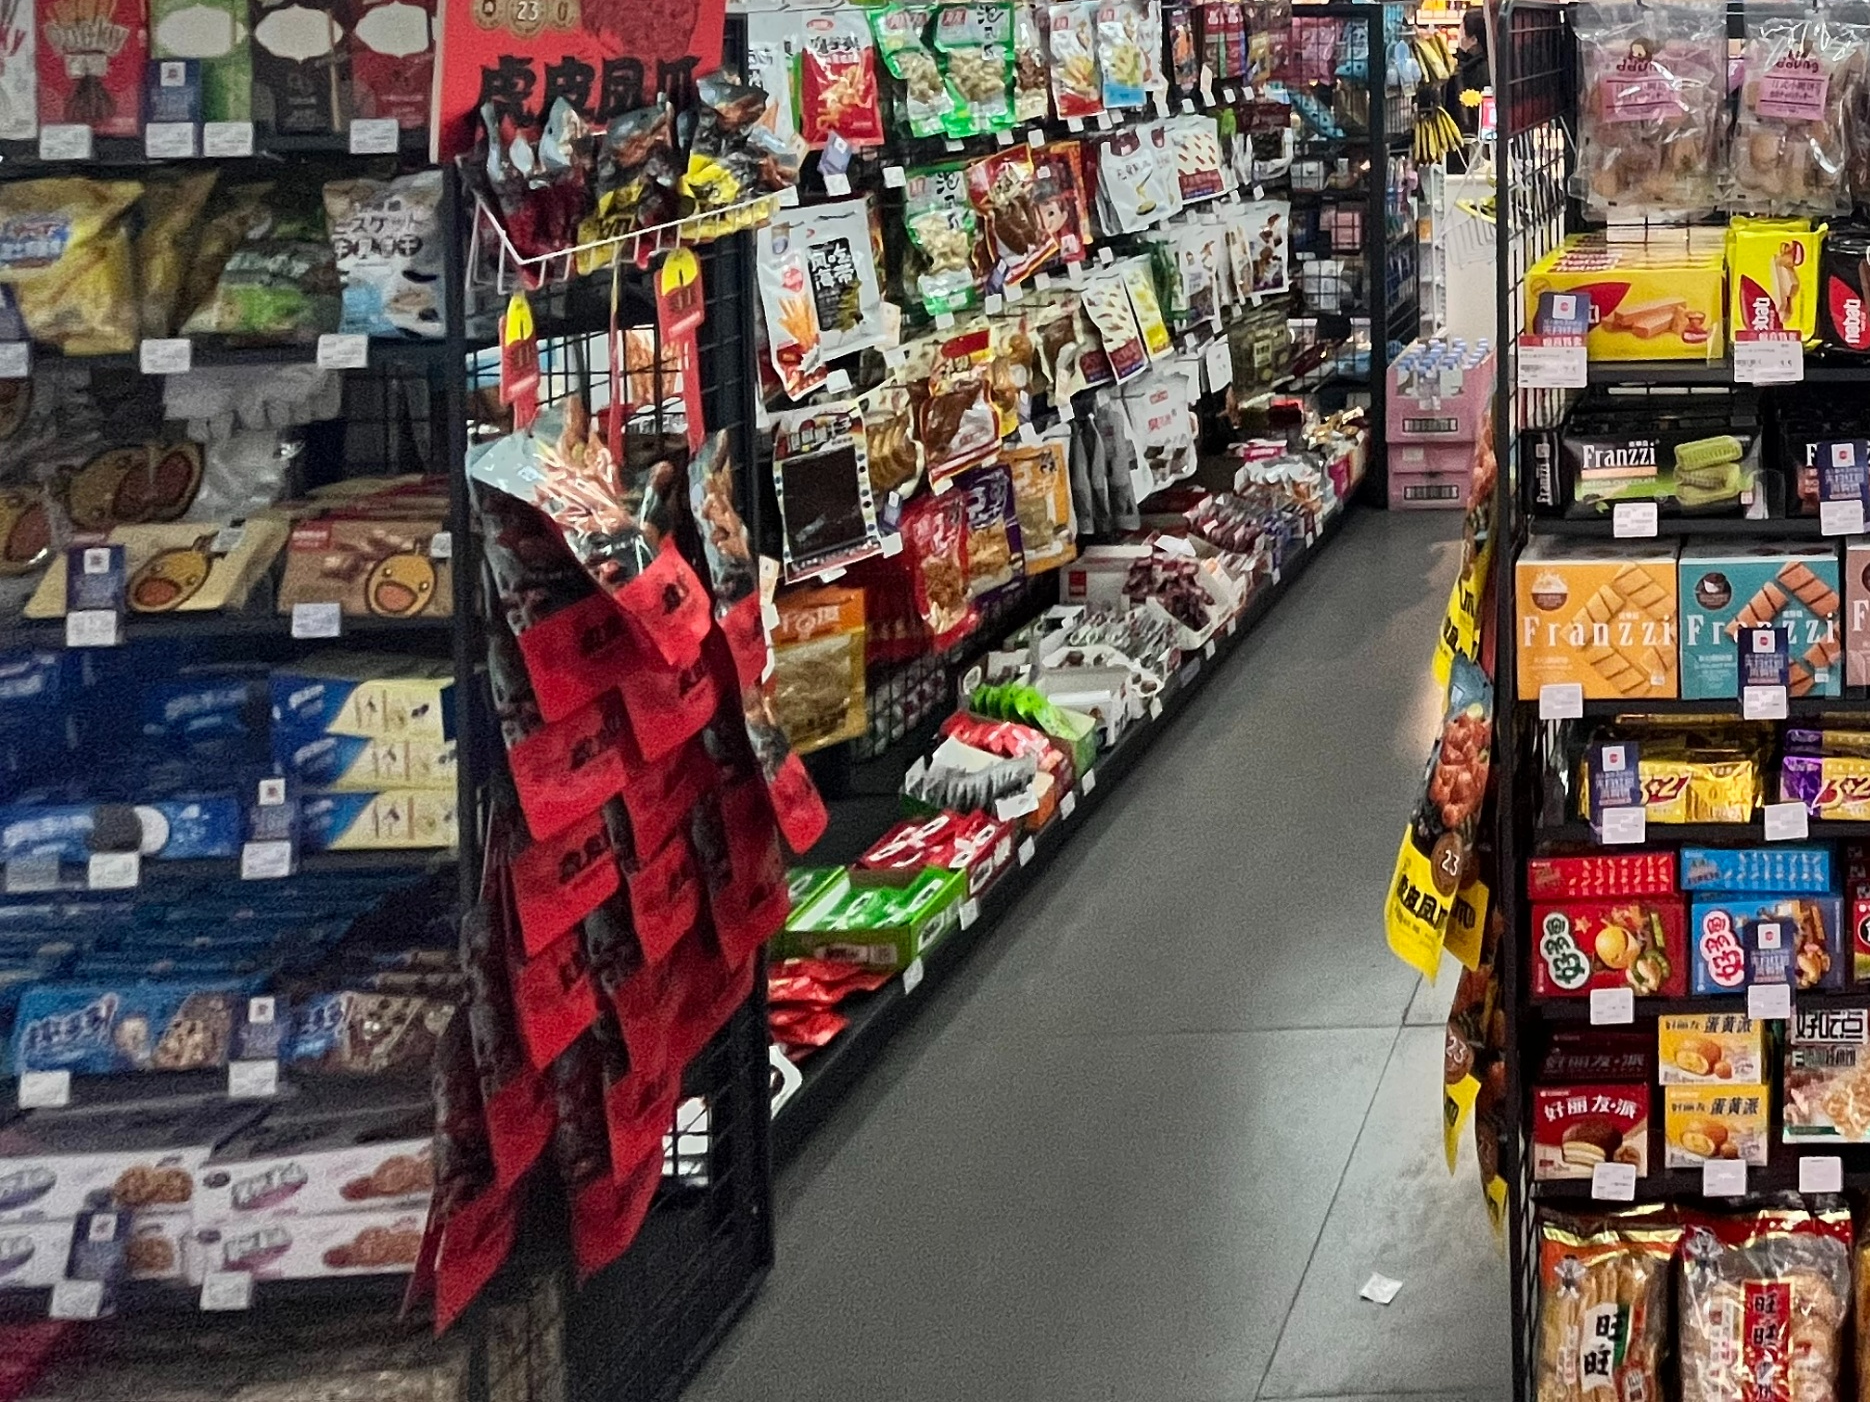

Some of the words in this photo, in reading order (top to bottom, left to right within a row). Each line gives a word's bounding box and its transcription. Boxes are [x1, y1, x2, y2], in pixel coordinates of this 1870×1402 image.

[516, 0, 539, 21] 23
[1775, 57, 1820, 74] ddung
[1845, 298, 1862, 345] nabati
[1582, 443, 1657, 469] Franzzi
[1523, 615, 1672, 647] Franzzi
[1639, 772, 1687, 798] 3+2
[1440, 850, 1459, 875] 23
[1704, 1016, 1753, 1035] 蛋黄派
[1794, 1010, 1864, 1040] 好吃点
[1544, 1096, 1638, 1120] 好丽友·派
[1710, 1097, 1759, 1116] 蛋黄派
[1753, 1292, 1780, 1346] 旺旺
[1583, 1312, 1620, 1377] 旺旺
